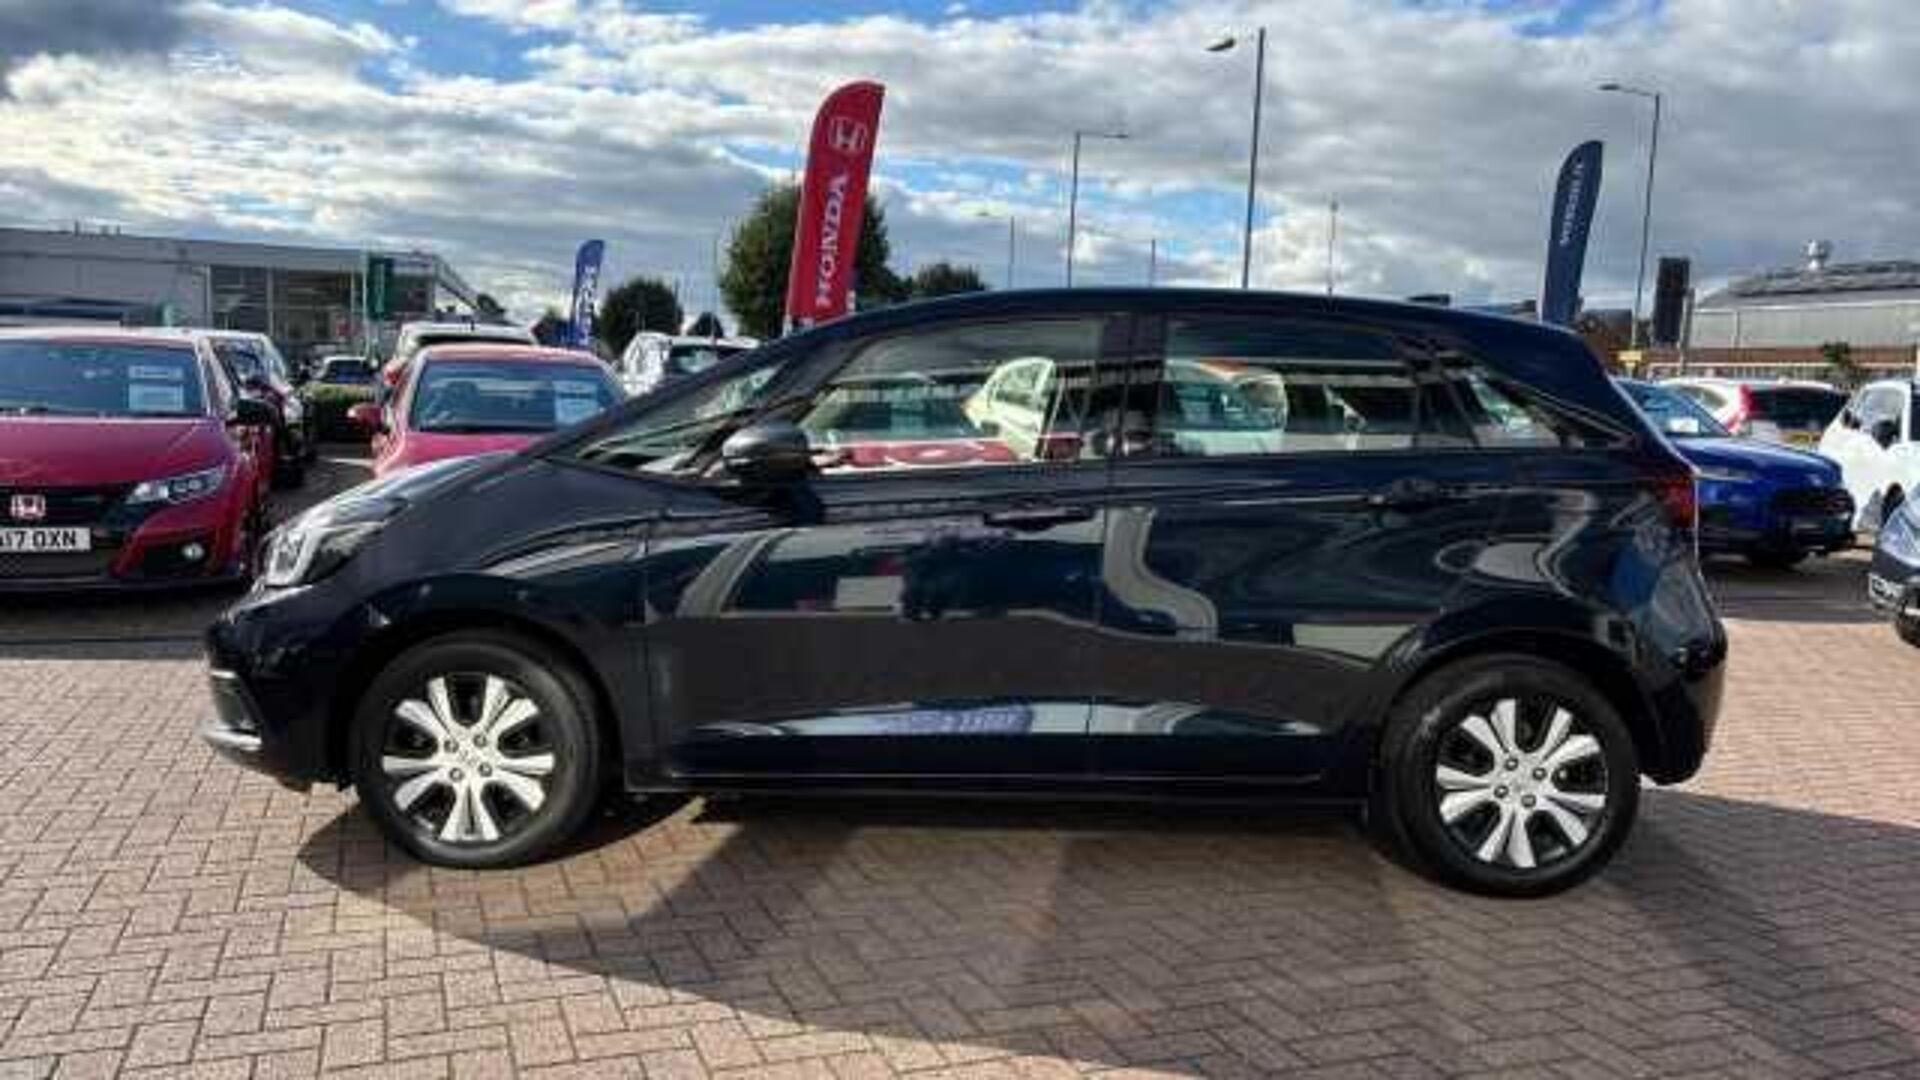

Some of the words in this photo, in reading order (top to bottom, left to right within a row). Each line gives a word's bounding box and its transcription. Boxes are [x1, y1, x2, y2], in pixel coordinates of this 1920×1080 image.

[814, 173, 850, 309] HONDA
[0, 530, 28, 549] 17
[32, 530, 77, 548] OXN
